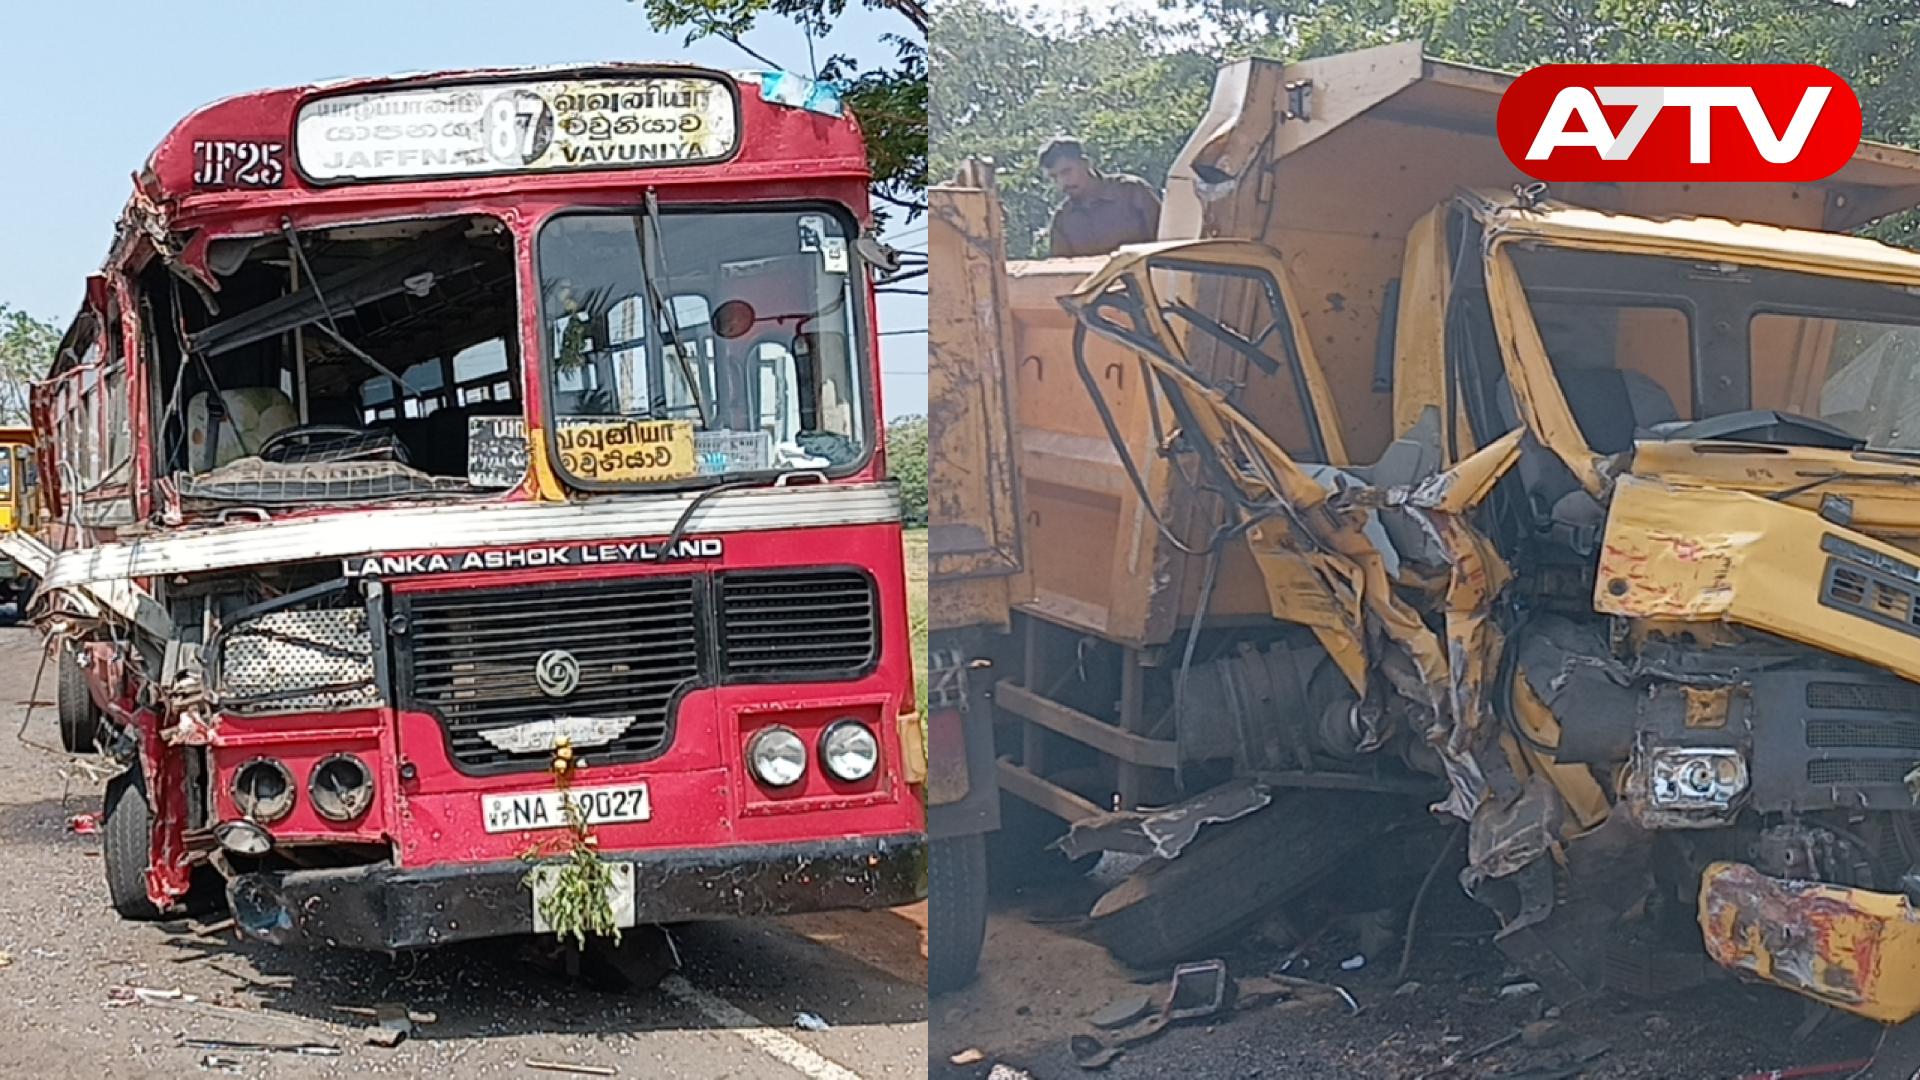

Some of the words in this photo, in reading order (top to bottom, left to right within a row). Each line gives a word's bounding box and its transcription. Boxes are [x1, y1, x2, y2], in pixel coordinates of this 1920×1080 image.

[490, 98, 542, 164] 87
[193, 141, 283, 185] JF25
[562, 142, 705, 163] VAVUNIYA
[342, 554, 451, 578] LANKA
[462, 547, 568, 569] ASHOK
[513, 797, 548, 826] NA
